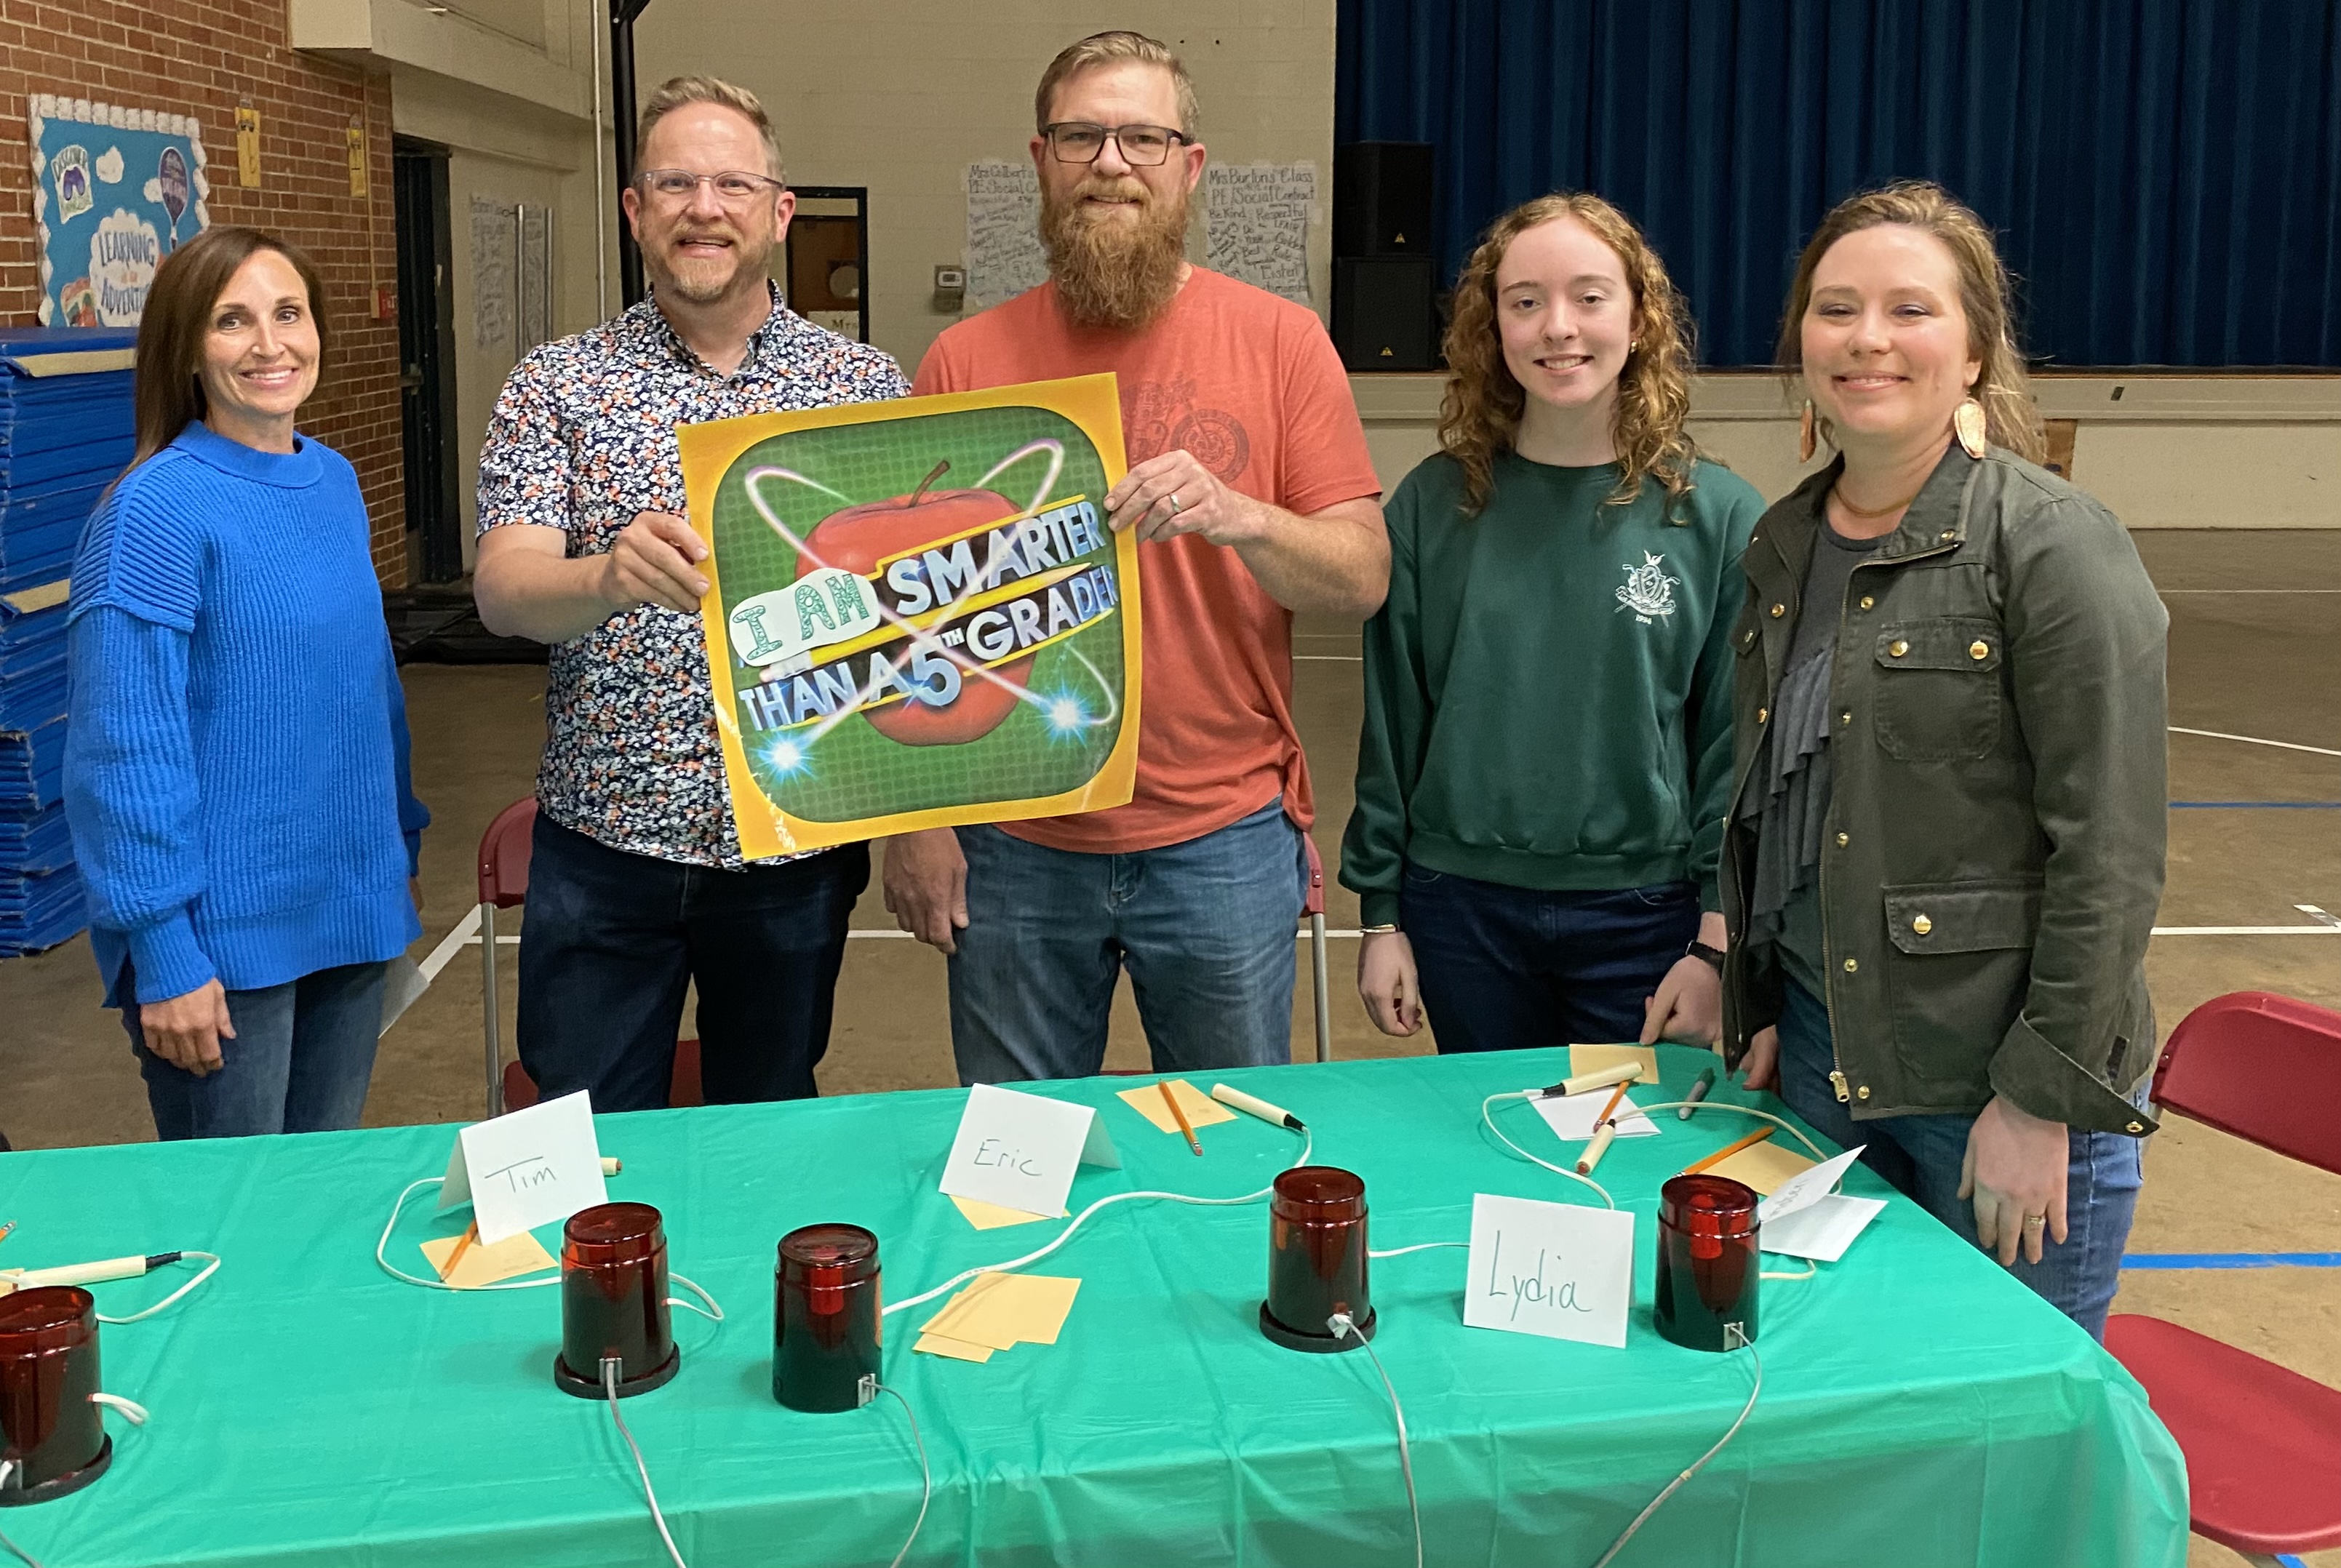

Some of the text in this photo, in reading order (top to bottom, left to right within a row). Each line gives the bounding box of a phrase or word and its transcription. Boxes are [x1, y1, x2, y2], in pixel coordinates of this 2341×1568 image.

[1280, 167, 1313, 183] Class
[1222, 206, 1247, 219] Kind
[1234, 185, 1273, 205] Social
[99, 231, 154, 268] LEARNING
[733, 501, 1106, 660] I AM SMARTER
[738, 661, 859, 732] THAN
[869, 651, 914, 703] A
[966, 564, 1118, 660] GRADER
[484, 1156, 557, 1193] Tim
[973, 1138, 1042, 1177] Eric
[1488, 1229, 1592, 1322] Lydia
